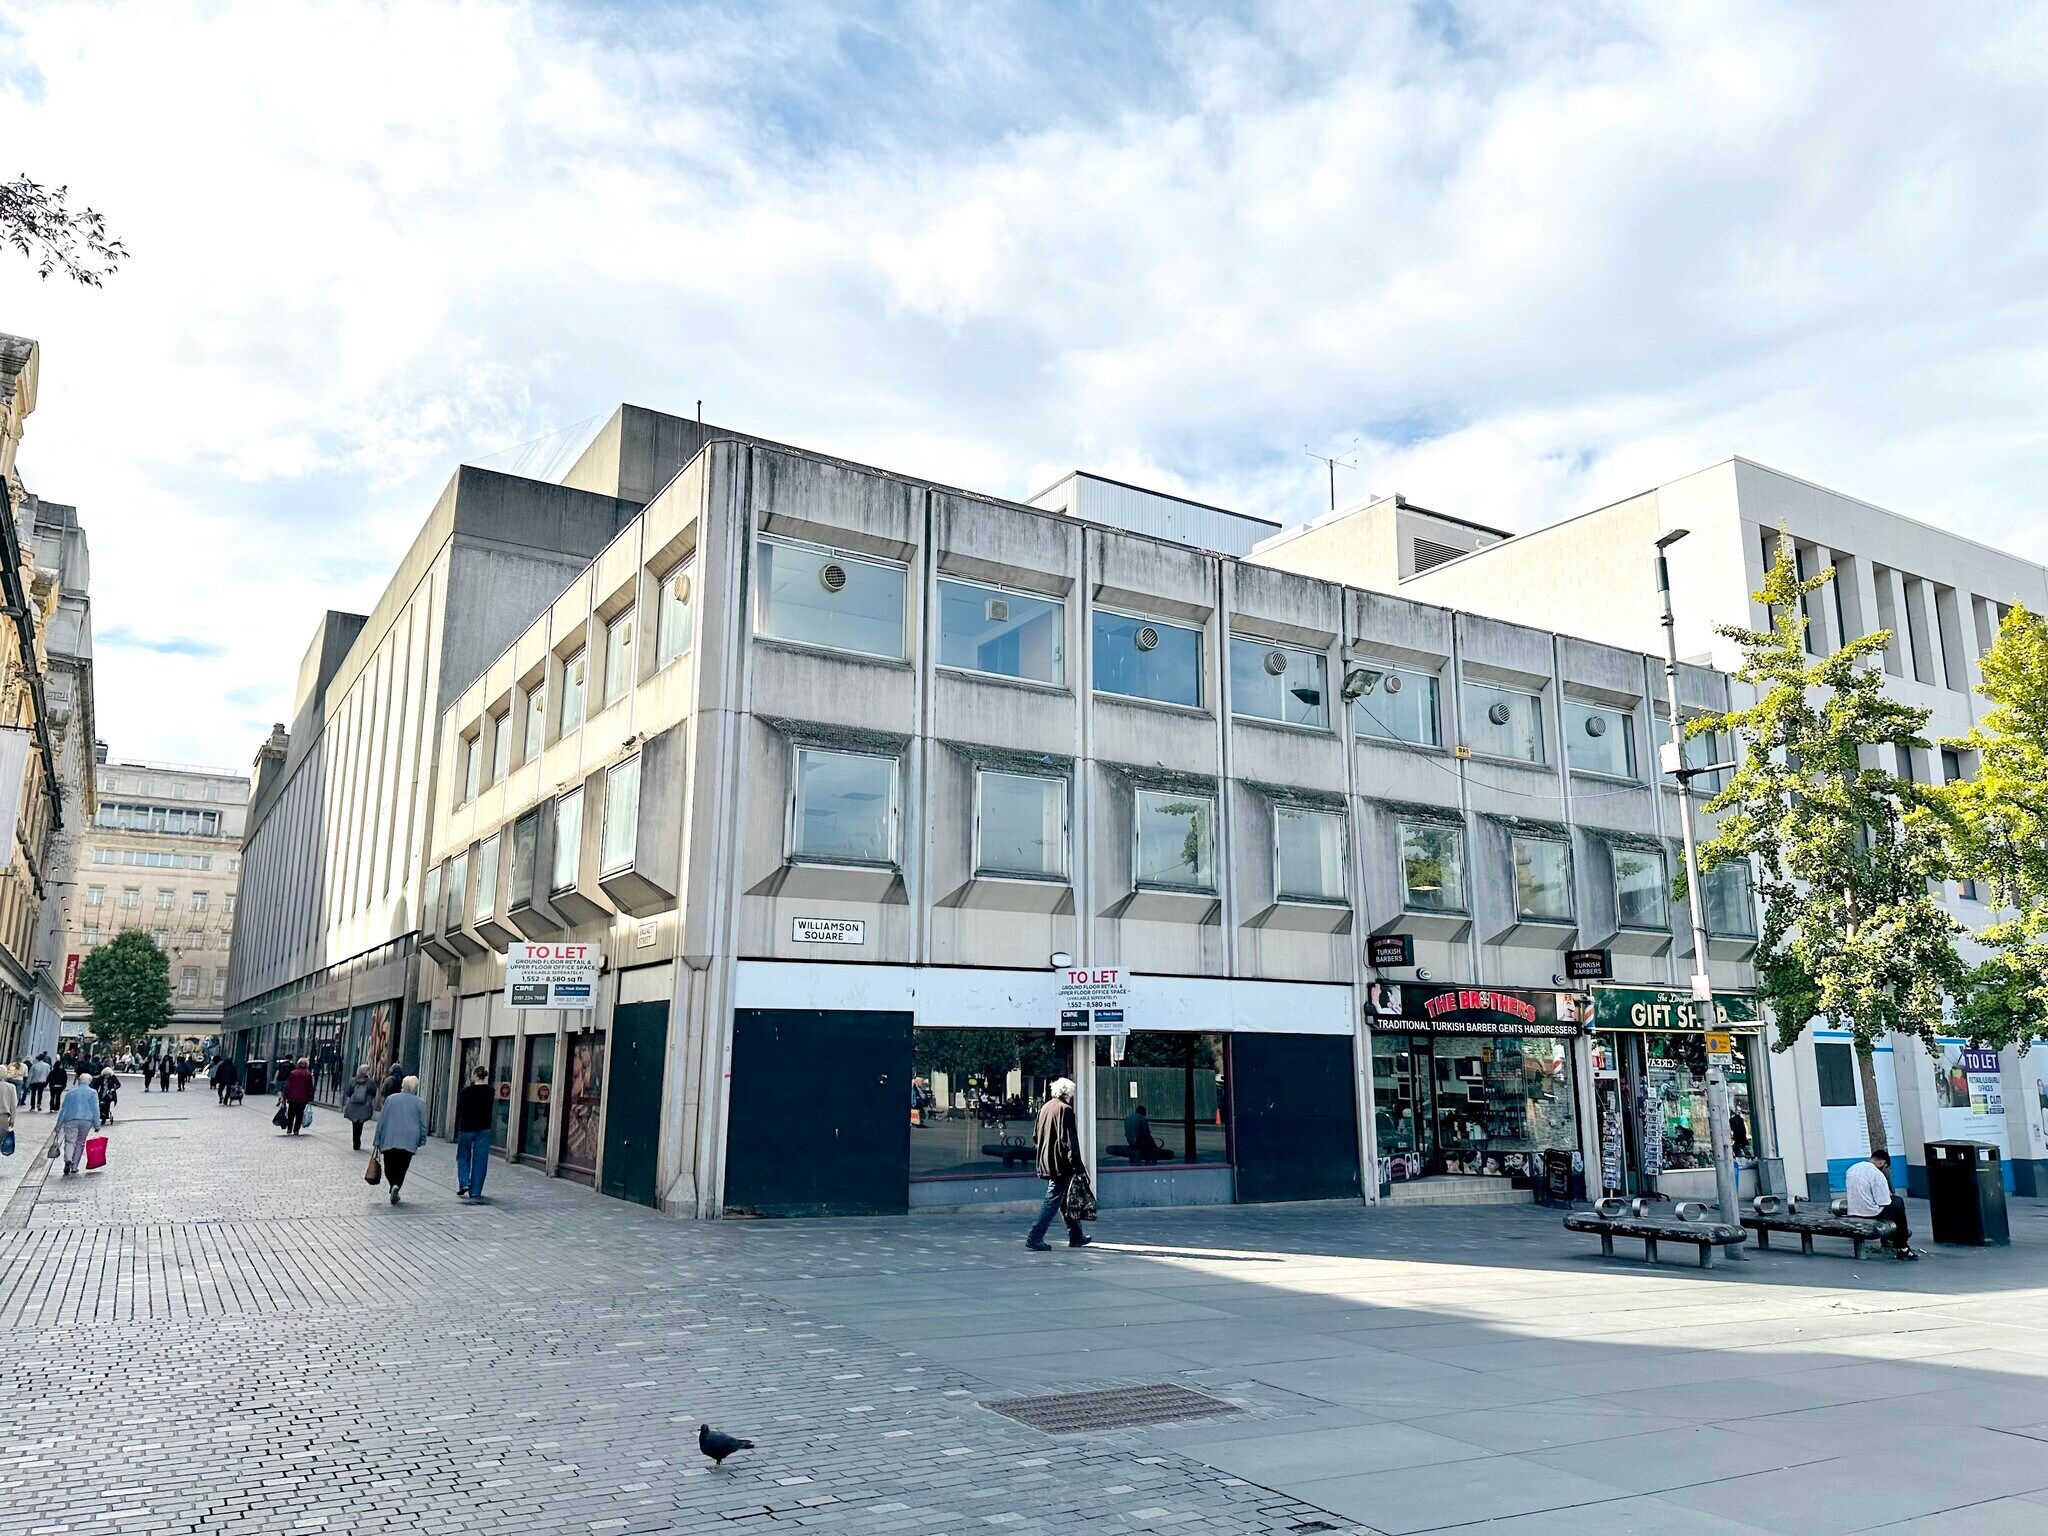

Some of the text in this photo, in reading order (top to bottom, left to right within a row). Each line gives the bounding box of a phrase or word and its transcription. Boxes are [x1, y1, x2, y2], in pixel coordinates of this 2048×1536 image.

[798, 921, 859, 932] WILLIAMSON
[804, 931, 843, 941] SQUARE
[525, 946, 587, 959] TO LET
[1376, 948, 1402, 956] TURKISH
[1375, 955, 1403, 963] BARBERS
[1574, 961, 1601, 969] TURKISH
[1068, 970, 1118, 984] TO LET
[1424, 991, 1536, 1023] THE BROTHERS
[1631, 1003, 1728, 1028] GIFT SHP
[1377, 1019, 1578, 1035] TRADITIONAL TURKISH BARBER GENTS HAIRDRESSERS
[1966, 1053, 1997, 1069] TO LET
